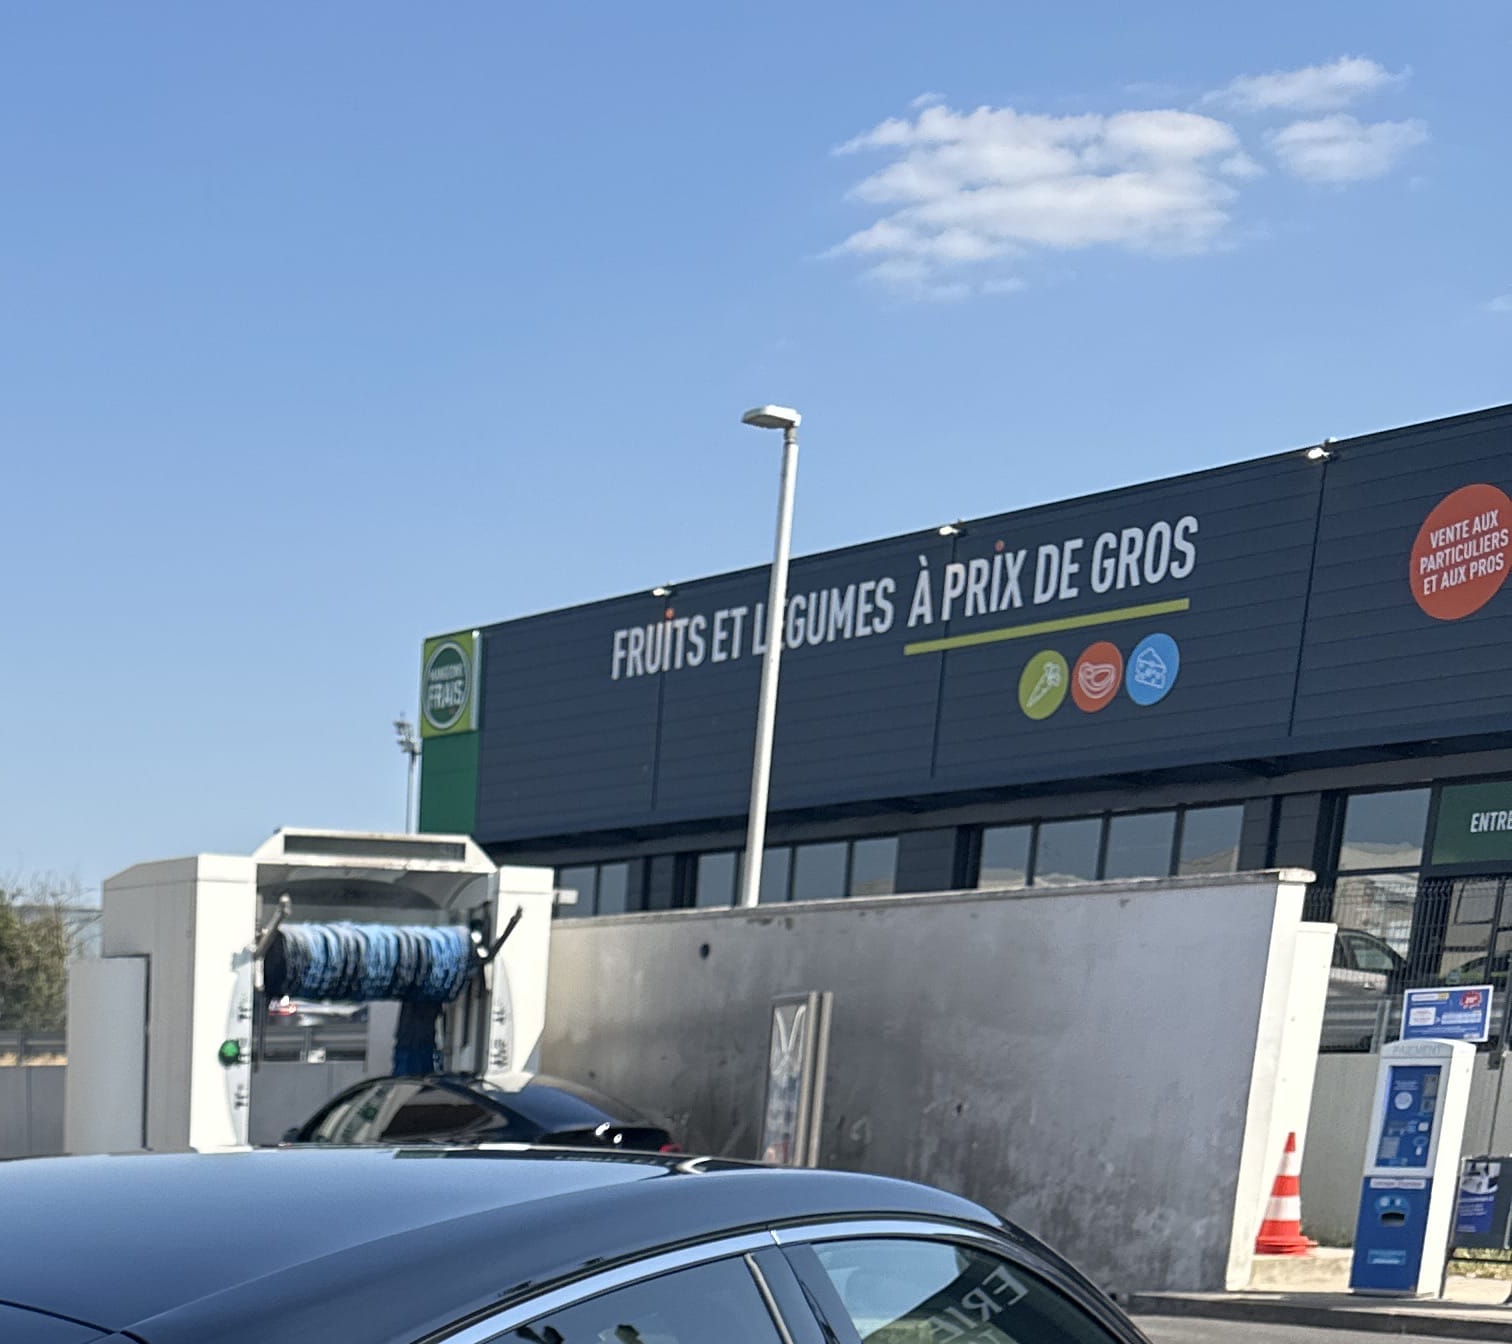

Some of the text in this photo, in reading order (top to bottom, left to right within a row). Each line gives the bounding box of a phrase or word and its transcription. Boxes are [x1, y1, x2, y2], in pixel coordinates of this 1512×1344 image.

[1430, 509, 1499, 549] VENTE AUX
[1420, 528, 1509, 575] PARTICULIERS
[1423, 553, 1504, 595] ET AUX PROS
[611, 516, 1199, 680] FRUITS ET LGUMES À PRIX DE GROS
